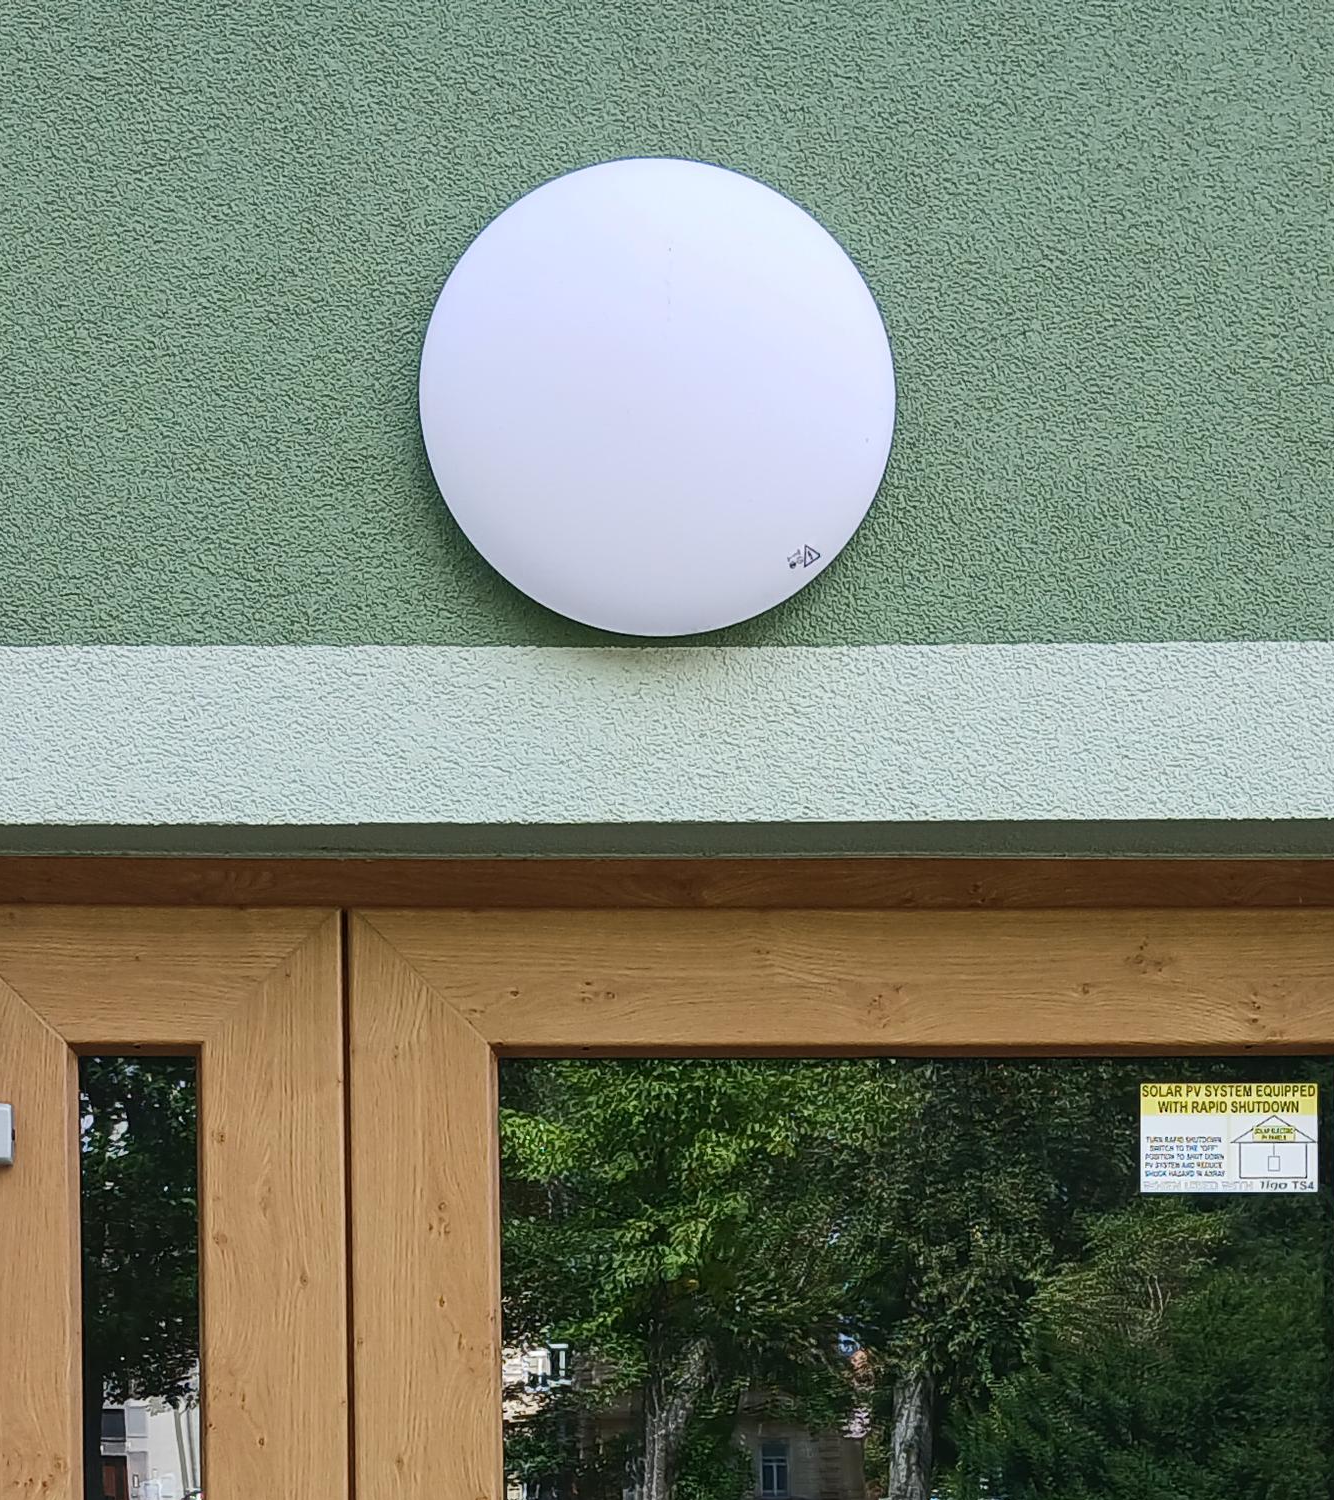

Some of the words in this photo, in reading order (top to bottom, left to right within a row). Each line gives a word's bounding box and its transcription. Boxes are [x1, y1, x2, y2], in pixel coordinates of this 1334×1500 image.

[1142, 1085, 1182, 1098] SOLAR
[1186, 1085, 1202, 1097] PV
[1204, 1085, 1252, 1097] SYSTEM
[1255, 1085, 1316, 1098] EQUIPPED
[1158, 1101, 1188, 1113] WITH
[1191, 1101, 1227, 1113] RAPID
[1230, 1101, 1299, 1113] SHUTDOWN
[1291, 1181, 1314, 1190] TS4
